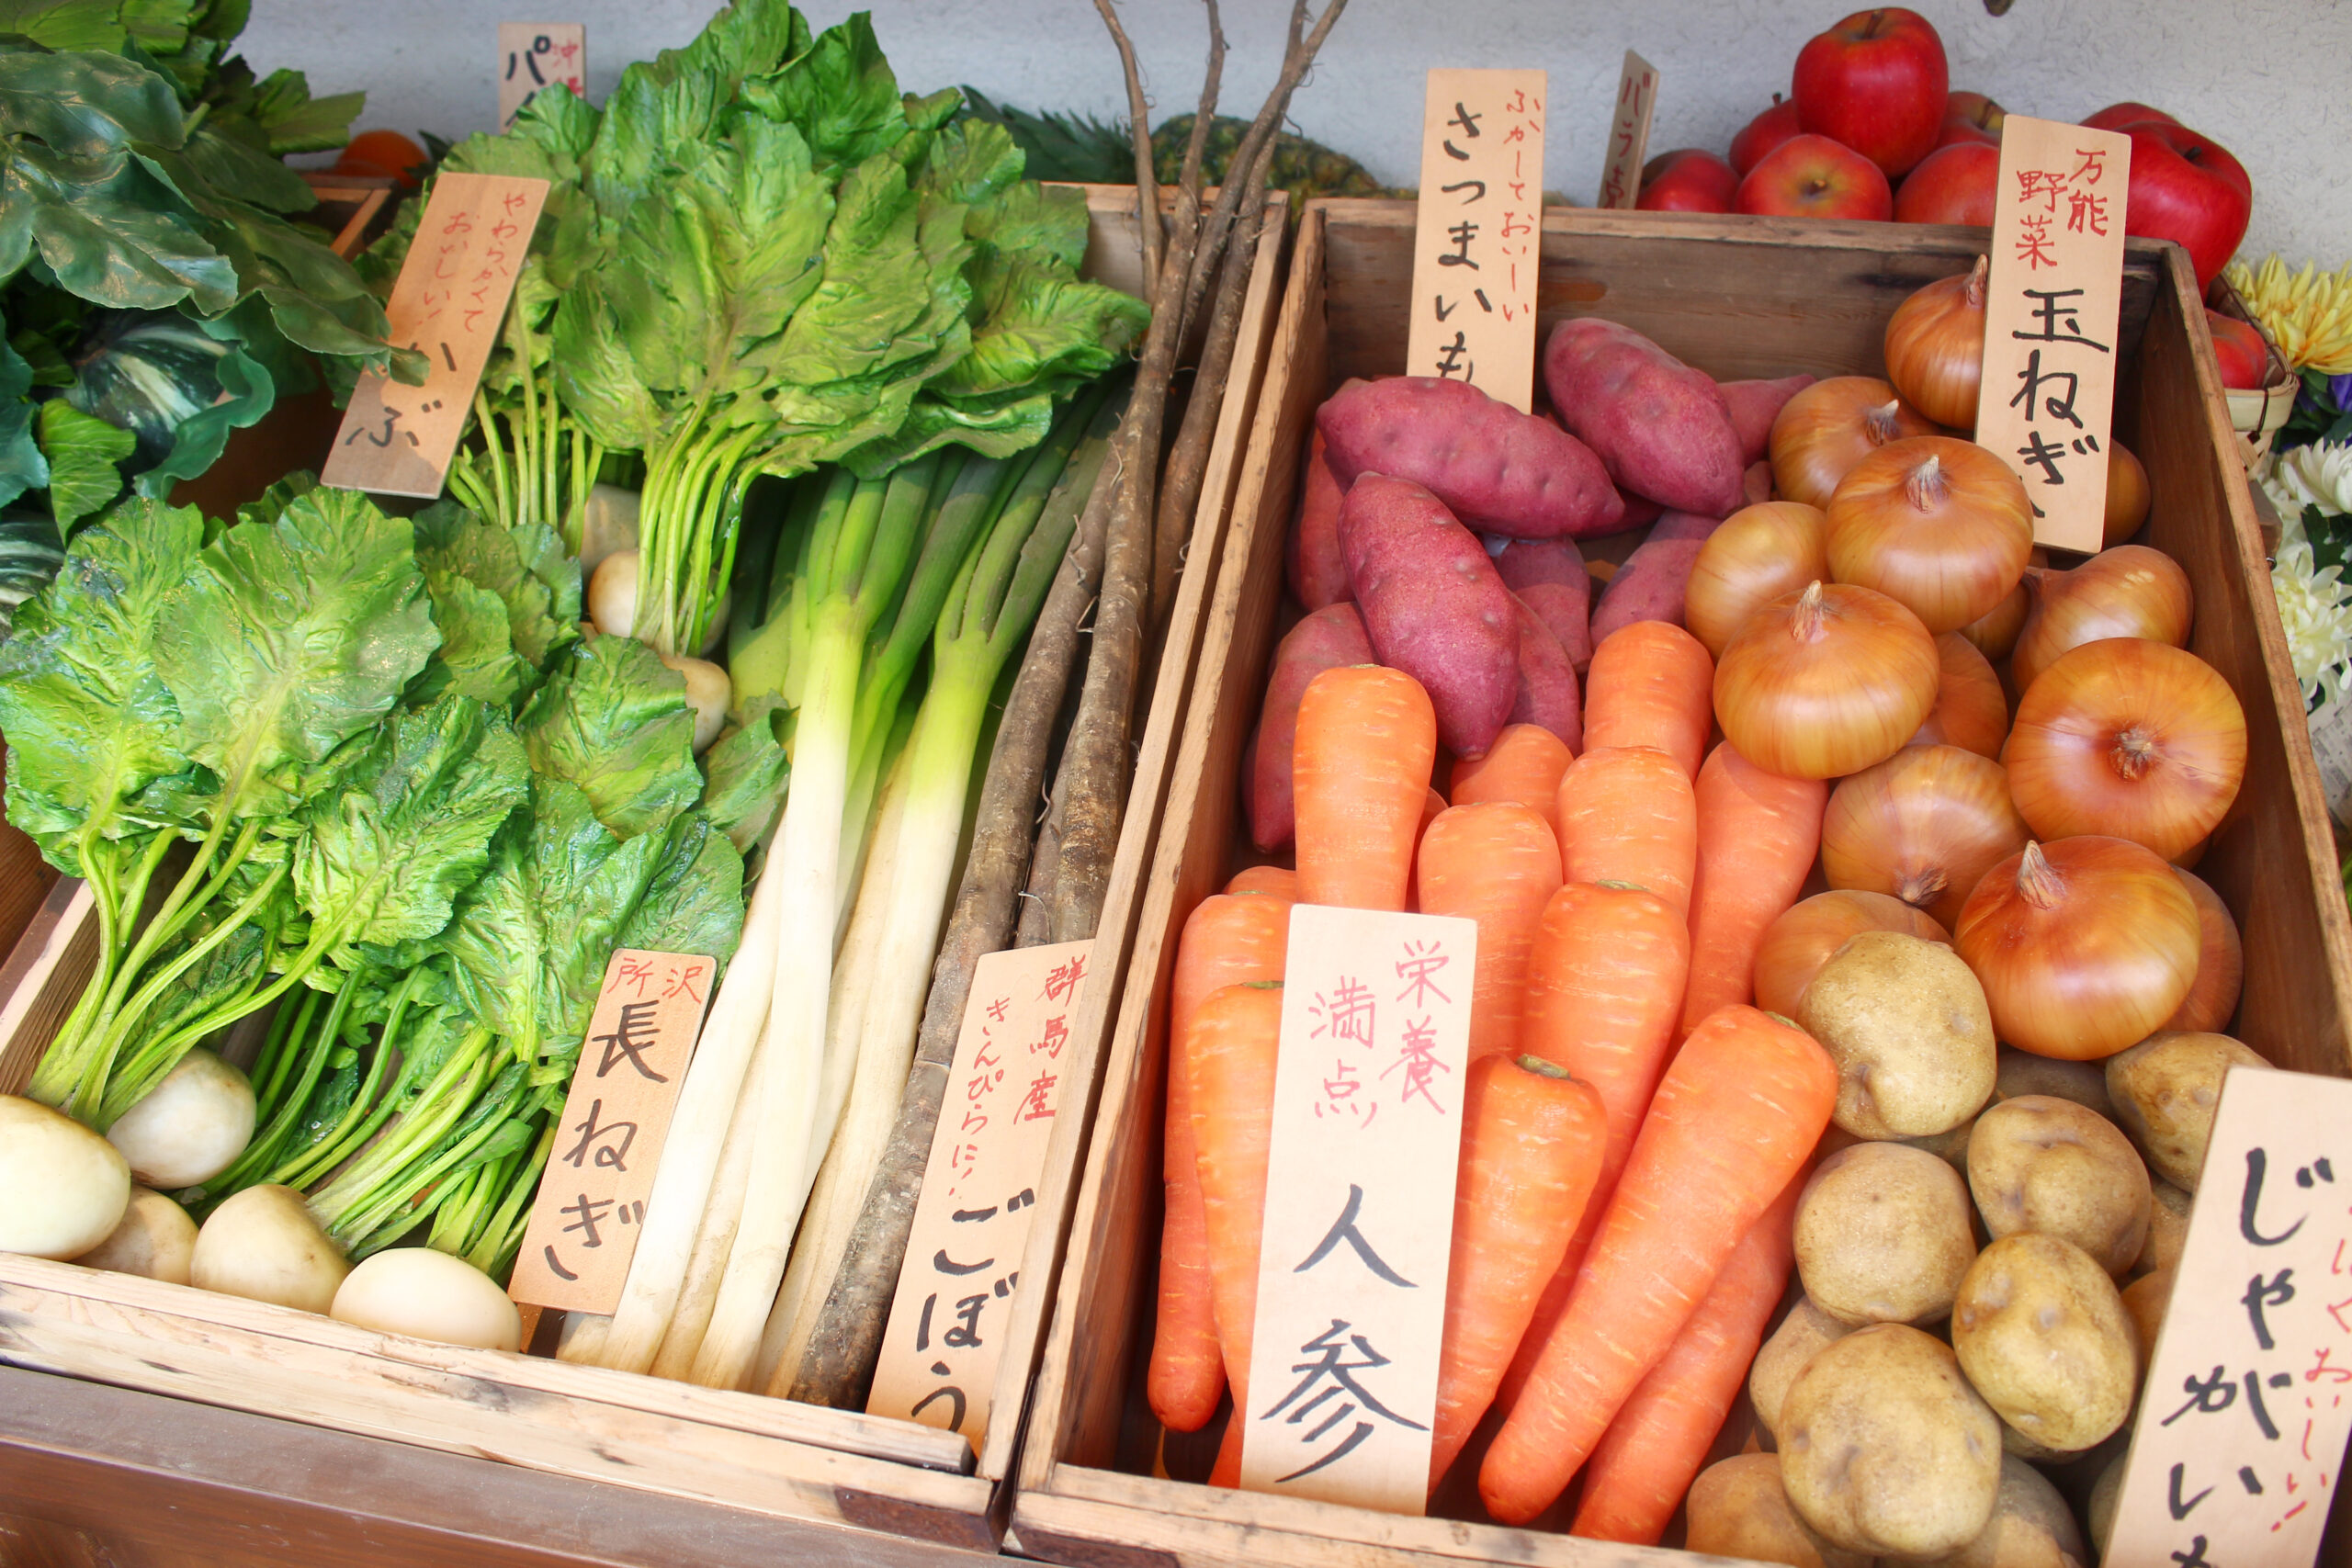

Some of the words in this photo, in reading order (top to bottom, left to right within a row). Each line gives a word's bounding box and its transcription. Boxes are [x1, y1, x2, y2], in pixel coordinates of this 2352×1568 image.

[464, 193, 526, 333] やわらかくて
[1435, 102, 1492, 382] さつまいも
[1500, 89, 1541, 322] ふかしておいしい
[2015, 170, 2069, 270] 野菜
[2067, 148, 2108, 237] 万能
[2010, 288, 2110, 518] 玉ねぎ
[606, 957, 704, 1004] 所沢
[1013, 953, 1088, 1124] 群馬産
[1308, 976, 1377, 1130] 満点
[1379, 940, 1452, 1114] 栄養
[544, 999, 669, 1281] 長ねぎ
[911, 1188, 1035, 1433] ごぼう
[1260, 1183, 1430, 1483] 人参
